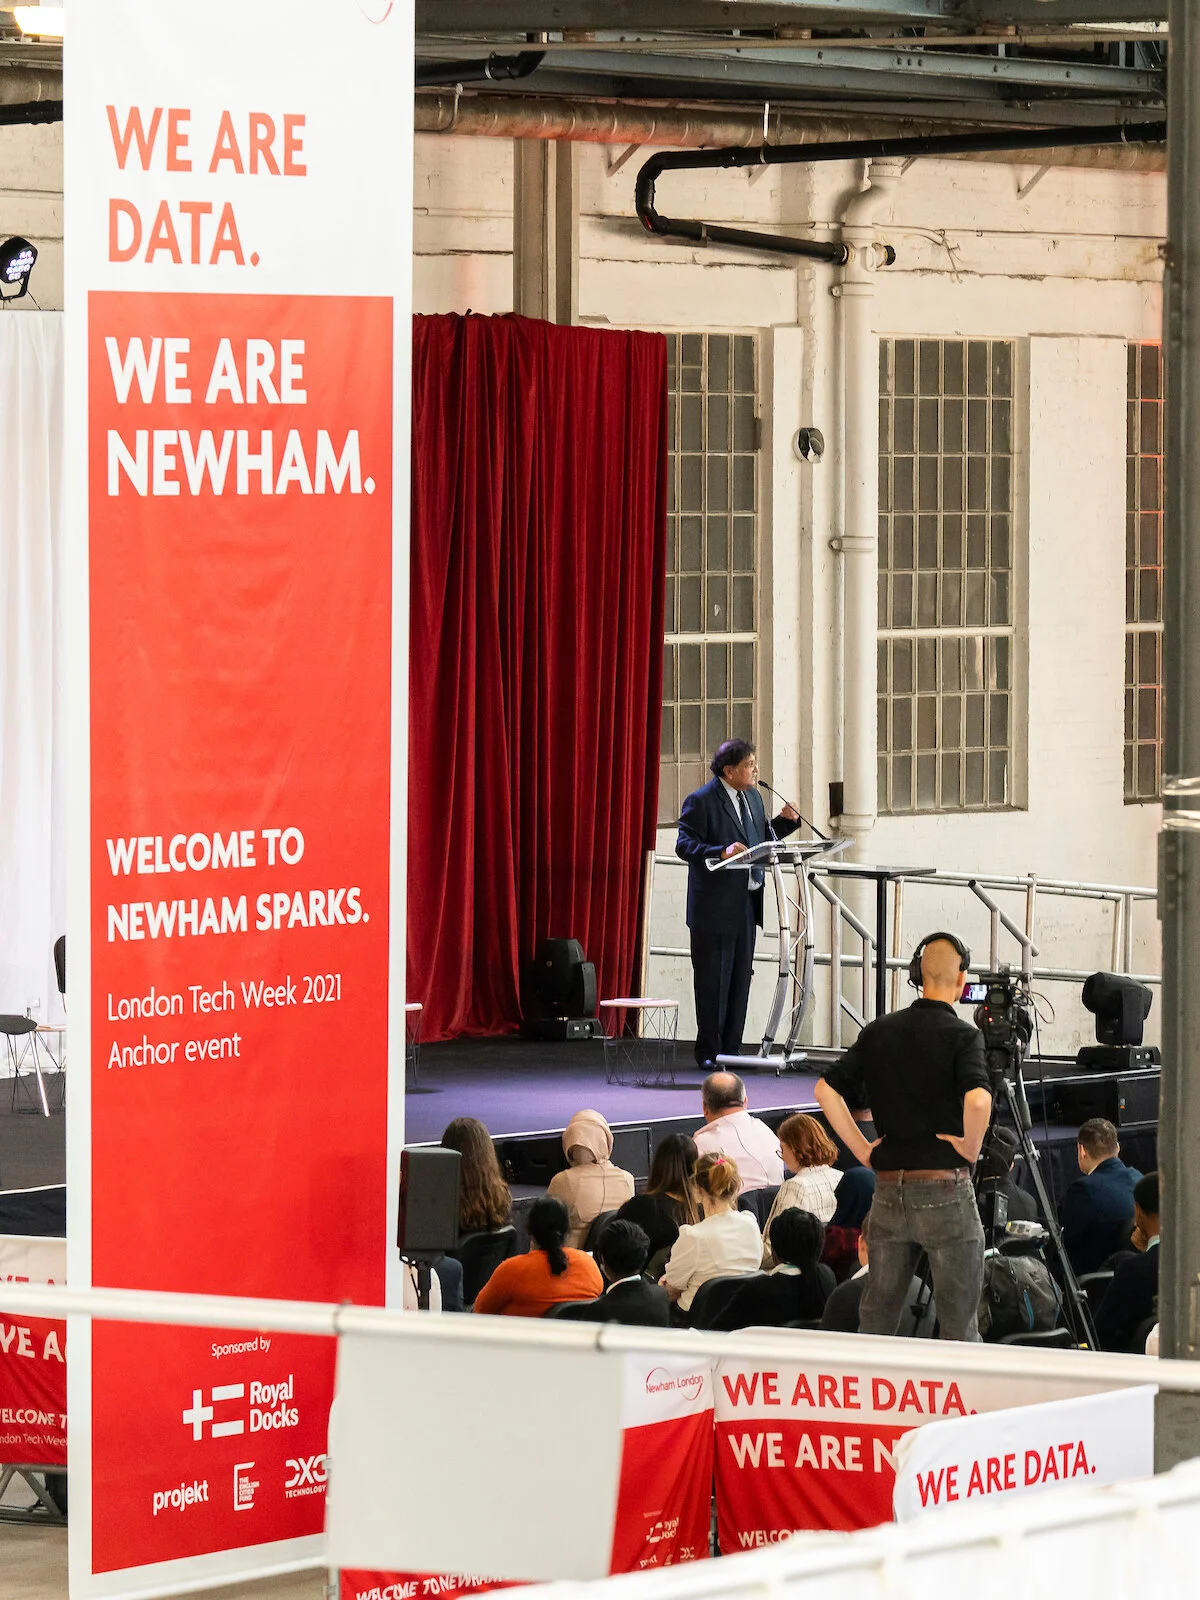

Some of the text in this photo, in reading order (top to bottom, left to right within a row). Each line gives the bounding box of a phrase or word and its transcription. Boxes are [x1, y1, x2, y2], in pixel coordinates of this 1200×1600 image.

[105, 105, 307, 177] WE ARE
[108, 199, 260, 268] DATA.
[105, 336, 307, 405] WE ARE
[107, 429, 376, 497] NEWHAM.
[106, 827, 304, 876] WELCOME TO
[107, 887, 370, 942] NEWHAM SPARKS.
[108, 974, 342, 1021] London Tech Week 2021
[107, 1033, 241, 1069] Anchor event
[211, 1336, 271, 1360] Sponsored by
[250, 1374, 293, 1409] Royal
[646, 1374, 704, 1394] Newham London
[722, 1372, 978, 1416] WE ARE DATA.
[250, 1402, 299, 1432] Docks
[43, 1435, 67, 1447] Wee
[728, 1432, 785, 1470] WE
[795, 1433, 864, 1472] ARE
[285, 1485, 327, 1498] TECHNOLOGY
[917, 1440, 1097, 1508] WE ARE DATA.
[153, 1480, 209, 1516] projekt
